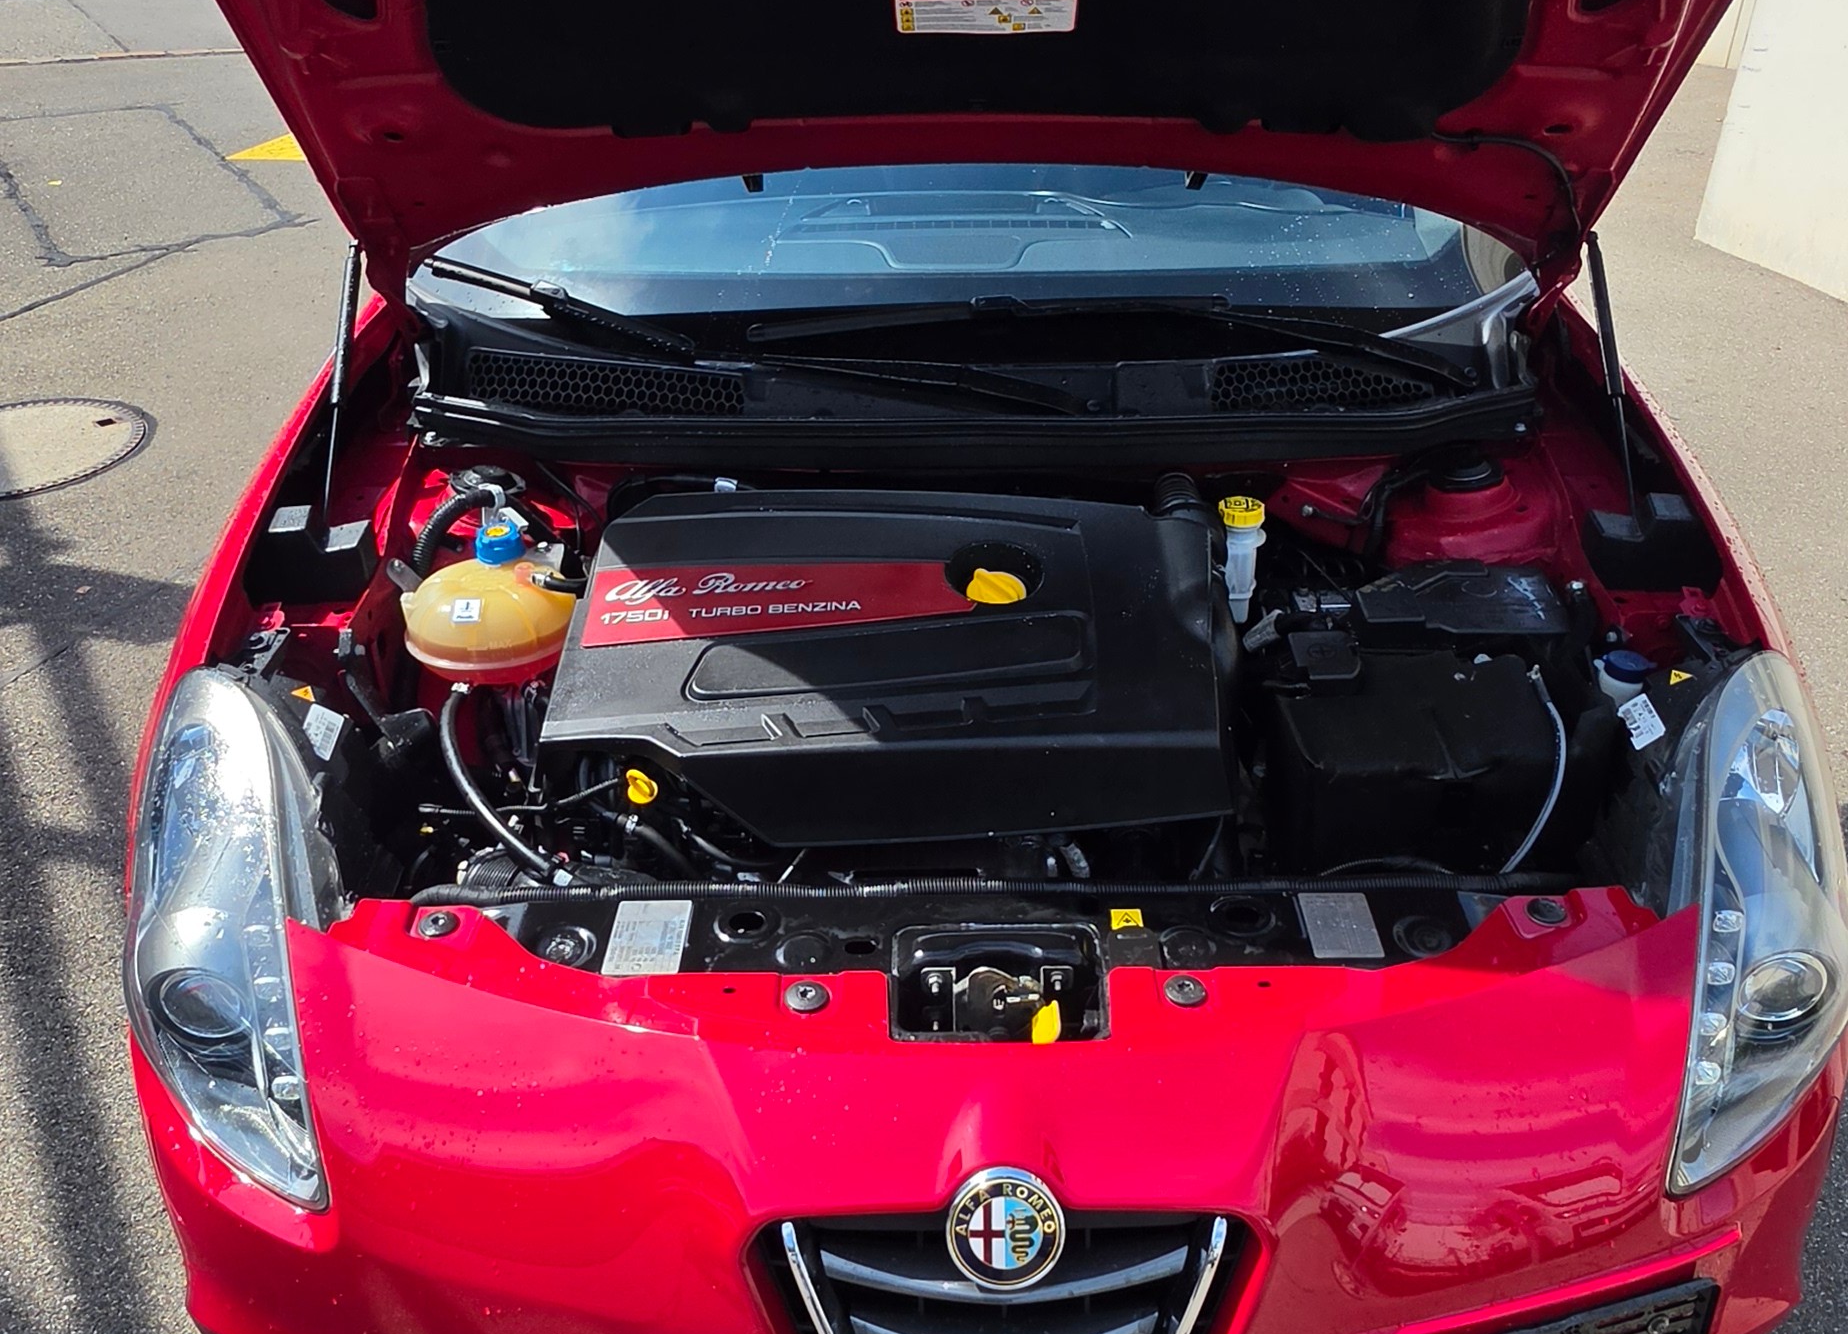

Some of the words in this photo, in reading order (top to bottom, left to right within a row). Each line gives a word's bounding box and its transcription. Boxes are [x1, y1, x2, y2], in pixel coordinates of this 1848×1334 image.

[604, 577, 687, 605] Alfa
[692, 572, 812, 594] Romeo
[600, 608, 670, 625] 1750i
[689, 605, 762, 618] TURBO
[768, 600, 862, 614] BENZINA
[955, 1189, 991, 1236] ALFA
[1002, 1183, 1056, 1234] ROMEO
